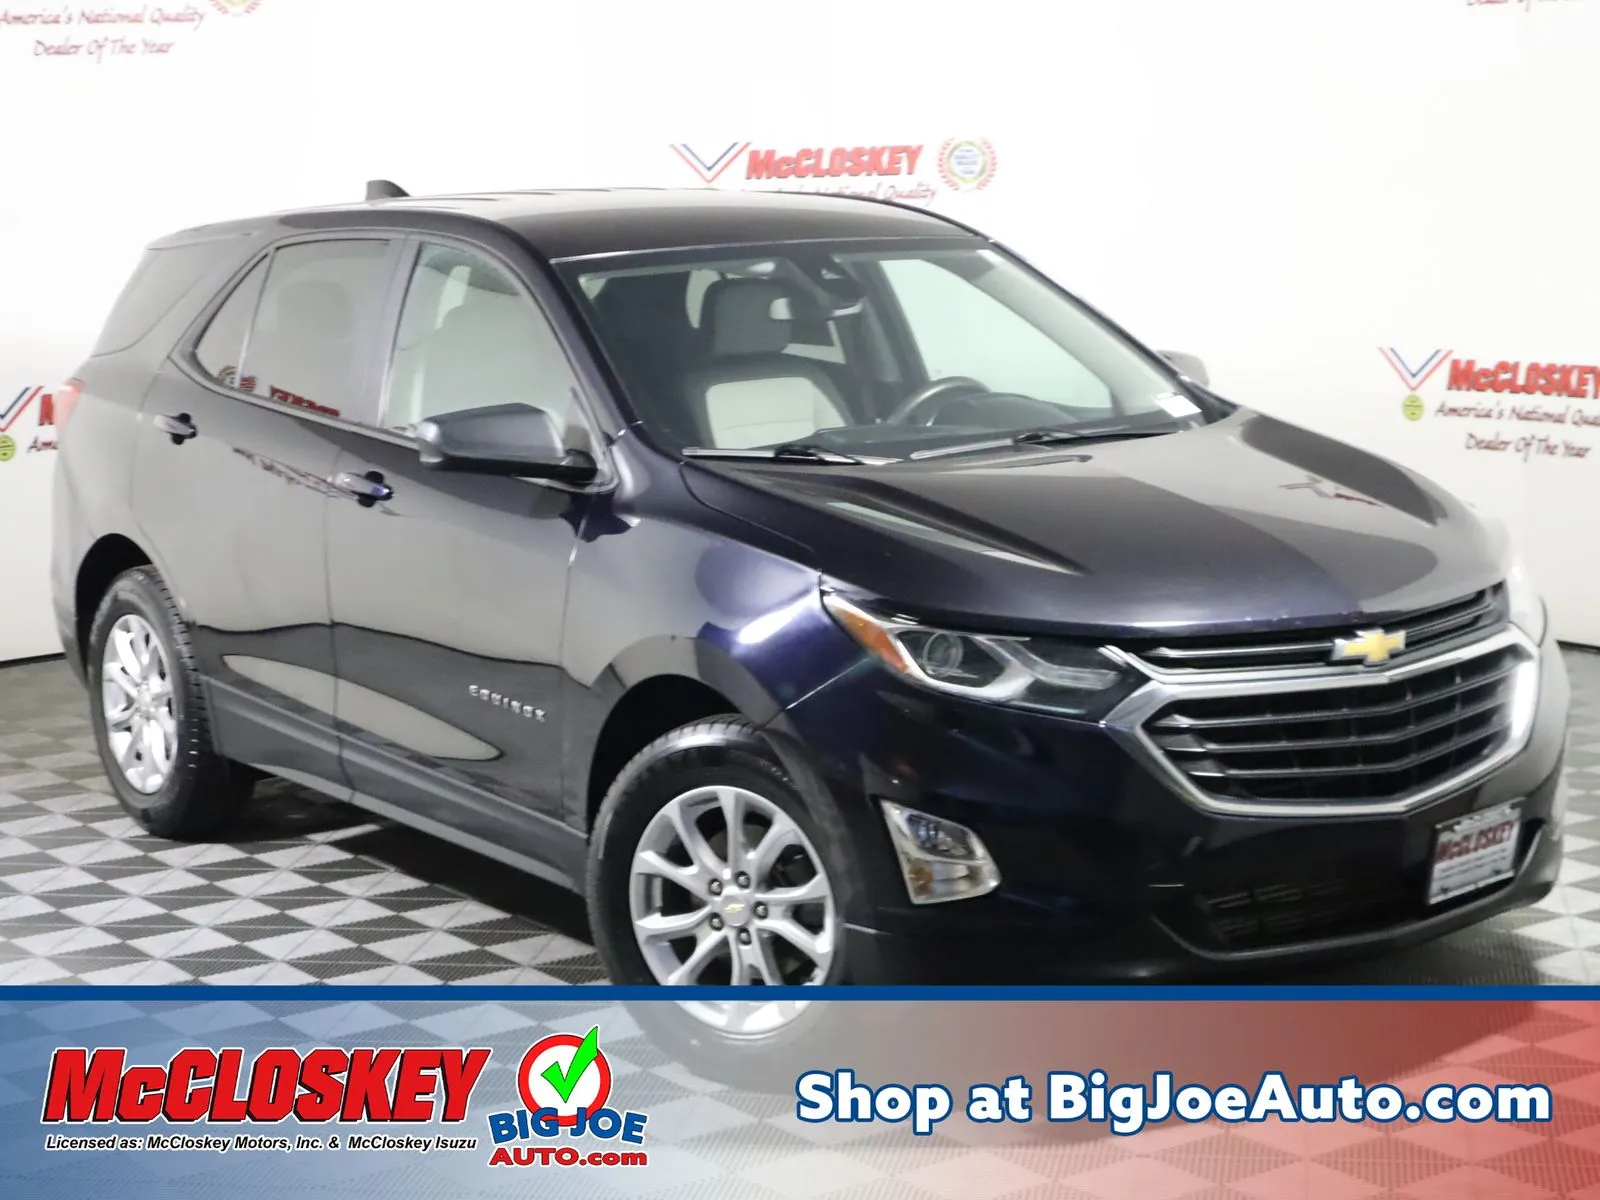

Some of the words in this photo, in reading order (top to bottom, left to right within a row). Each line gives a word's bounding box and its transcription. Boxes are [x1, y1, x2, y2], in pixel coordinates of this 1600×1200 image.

[79, 5, 145, 24] National
[150, 4, 206, 31] Quality
[33, 37, 84, 56] Dealer
[110, 37, 137, 55] The
[142, 38, 175, 54] Year
[745, 146, 923, 179] McCLOSKEY
[1434, 400, 1504, 420] America's
[1508, 404, 1571, 424] National
[1465, 432, 1512, 451] Dealer
[1536, 435, 1559, 455] The
[1561, 439, 1591, 458] Year
[468, 684, 546, 723] EQUINOX
